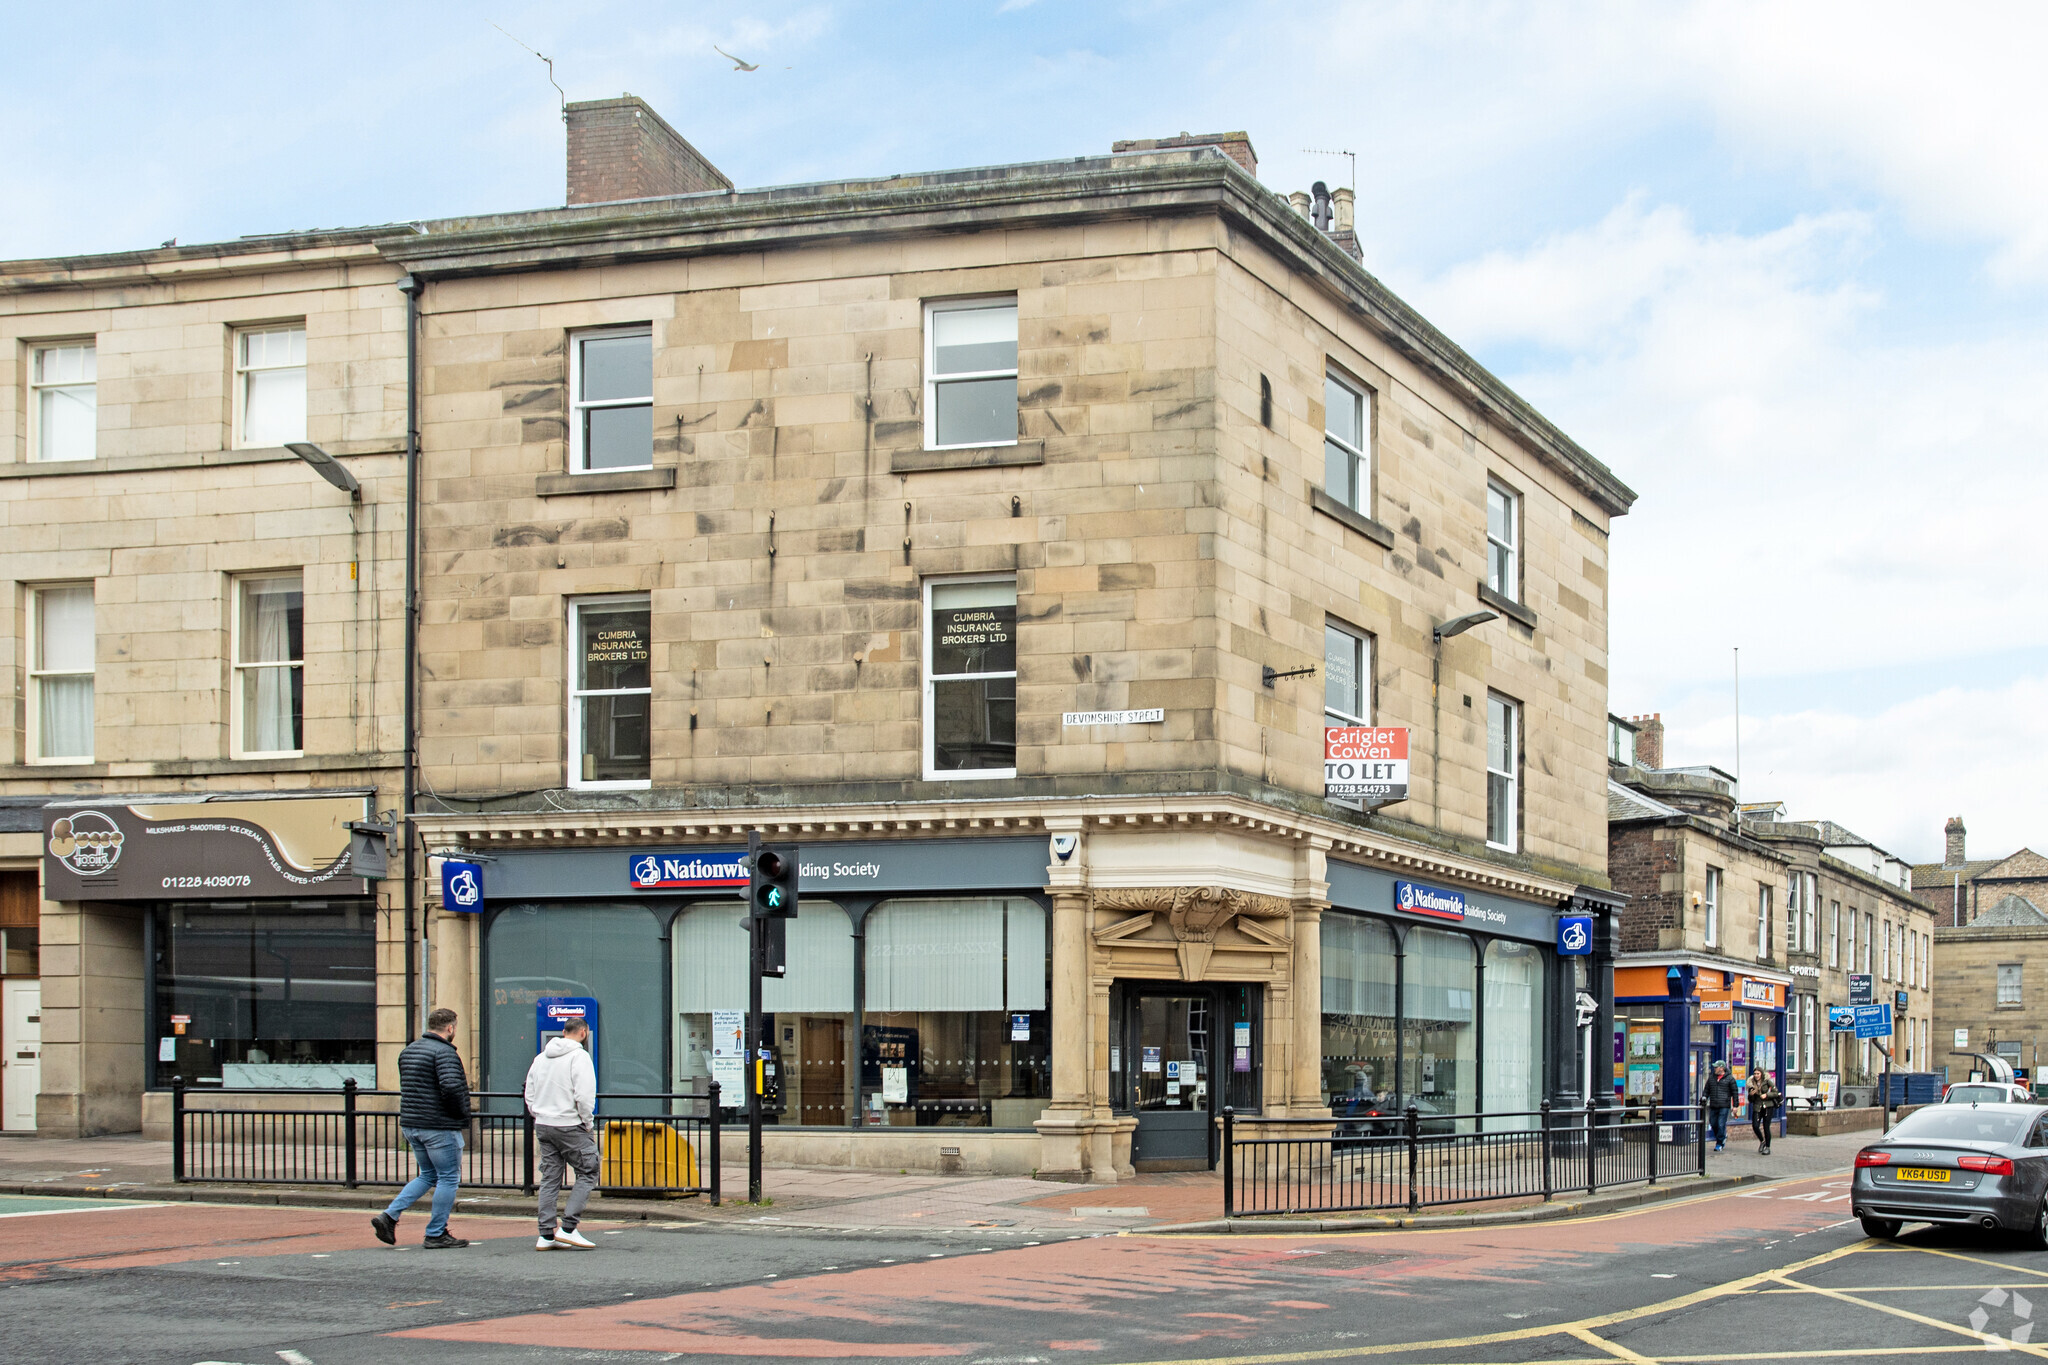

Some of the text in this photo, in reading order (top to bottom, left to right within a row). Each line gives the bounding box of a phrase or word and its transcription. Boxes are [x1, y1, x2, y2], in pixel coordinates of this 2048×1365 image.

[953, 612, 995, 622] CUMBRIA
[947, 622, 1002, 634] INSURANCE
[598, 630, 636, 640] CUMBRIA
[942, 634, 1007, 644] BROKERS LTD
[592, 640, 642, 651] INSURANCE
[588, 651, 648, 662] BROKERS LTD
[1066, 710, 1161, 724] DEVONSHIRE STREET
[1329, 744, 1390, 758] Cowen
[1325, 763, 1396, 780] TO LET
[1328, 784, 1391, 794] 01228 544733
[146, 824, 186, 834] MILKSHAKES
[240, 827, 262, 843] CREAM
[262, 842, 282, 872] WAFFLES
[283, 871, 308, 884] CREPES
[833, 862, 880, 878] Society
[162, 875, 251, 888] 01228 409078
[1414, 889, 1506, 925] Nationwide Building Society
[1789, 965, 1814, 977] SPORTS
[1338, 1014, 1395, 1030] COMMUNIT
[1901, 1170, 1947, 1180] YK64 USD
